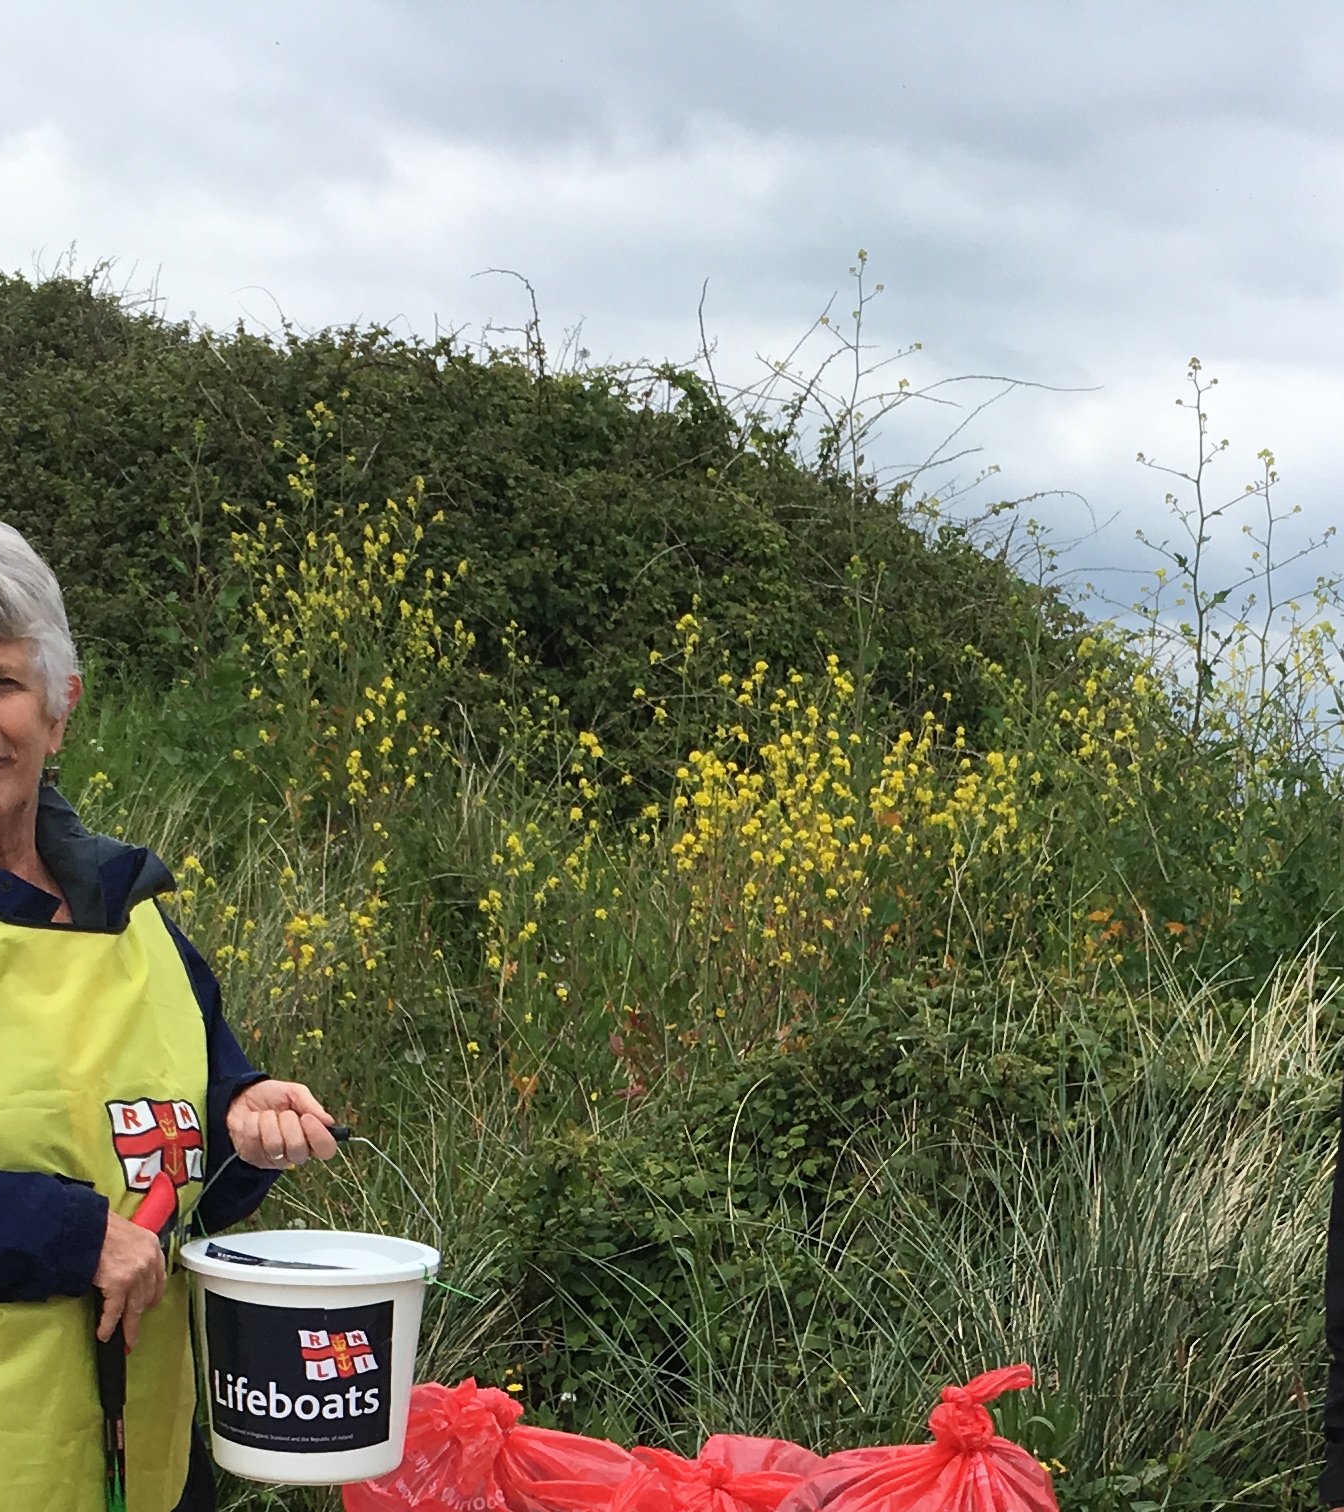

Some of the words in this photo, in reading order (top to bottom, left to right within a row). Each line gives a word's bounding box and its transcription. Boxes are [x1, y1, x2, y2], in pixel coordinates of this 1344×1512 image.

[121, 1107, 142, 1130] R
[177, 1105, 193, 1125] N
[134, 1160, 153, 1184] L
[308, 1334, 323, 1347] R
[350, 1332, 364, 1344] N
[316, 1364, 330, 1378] L
[360, 1358, 369, 1370] I
[214, 1369, 380, 1420] Lifeboats
